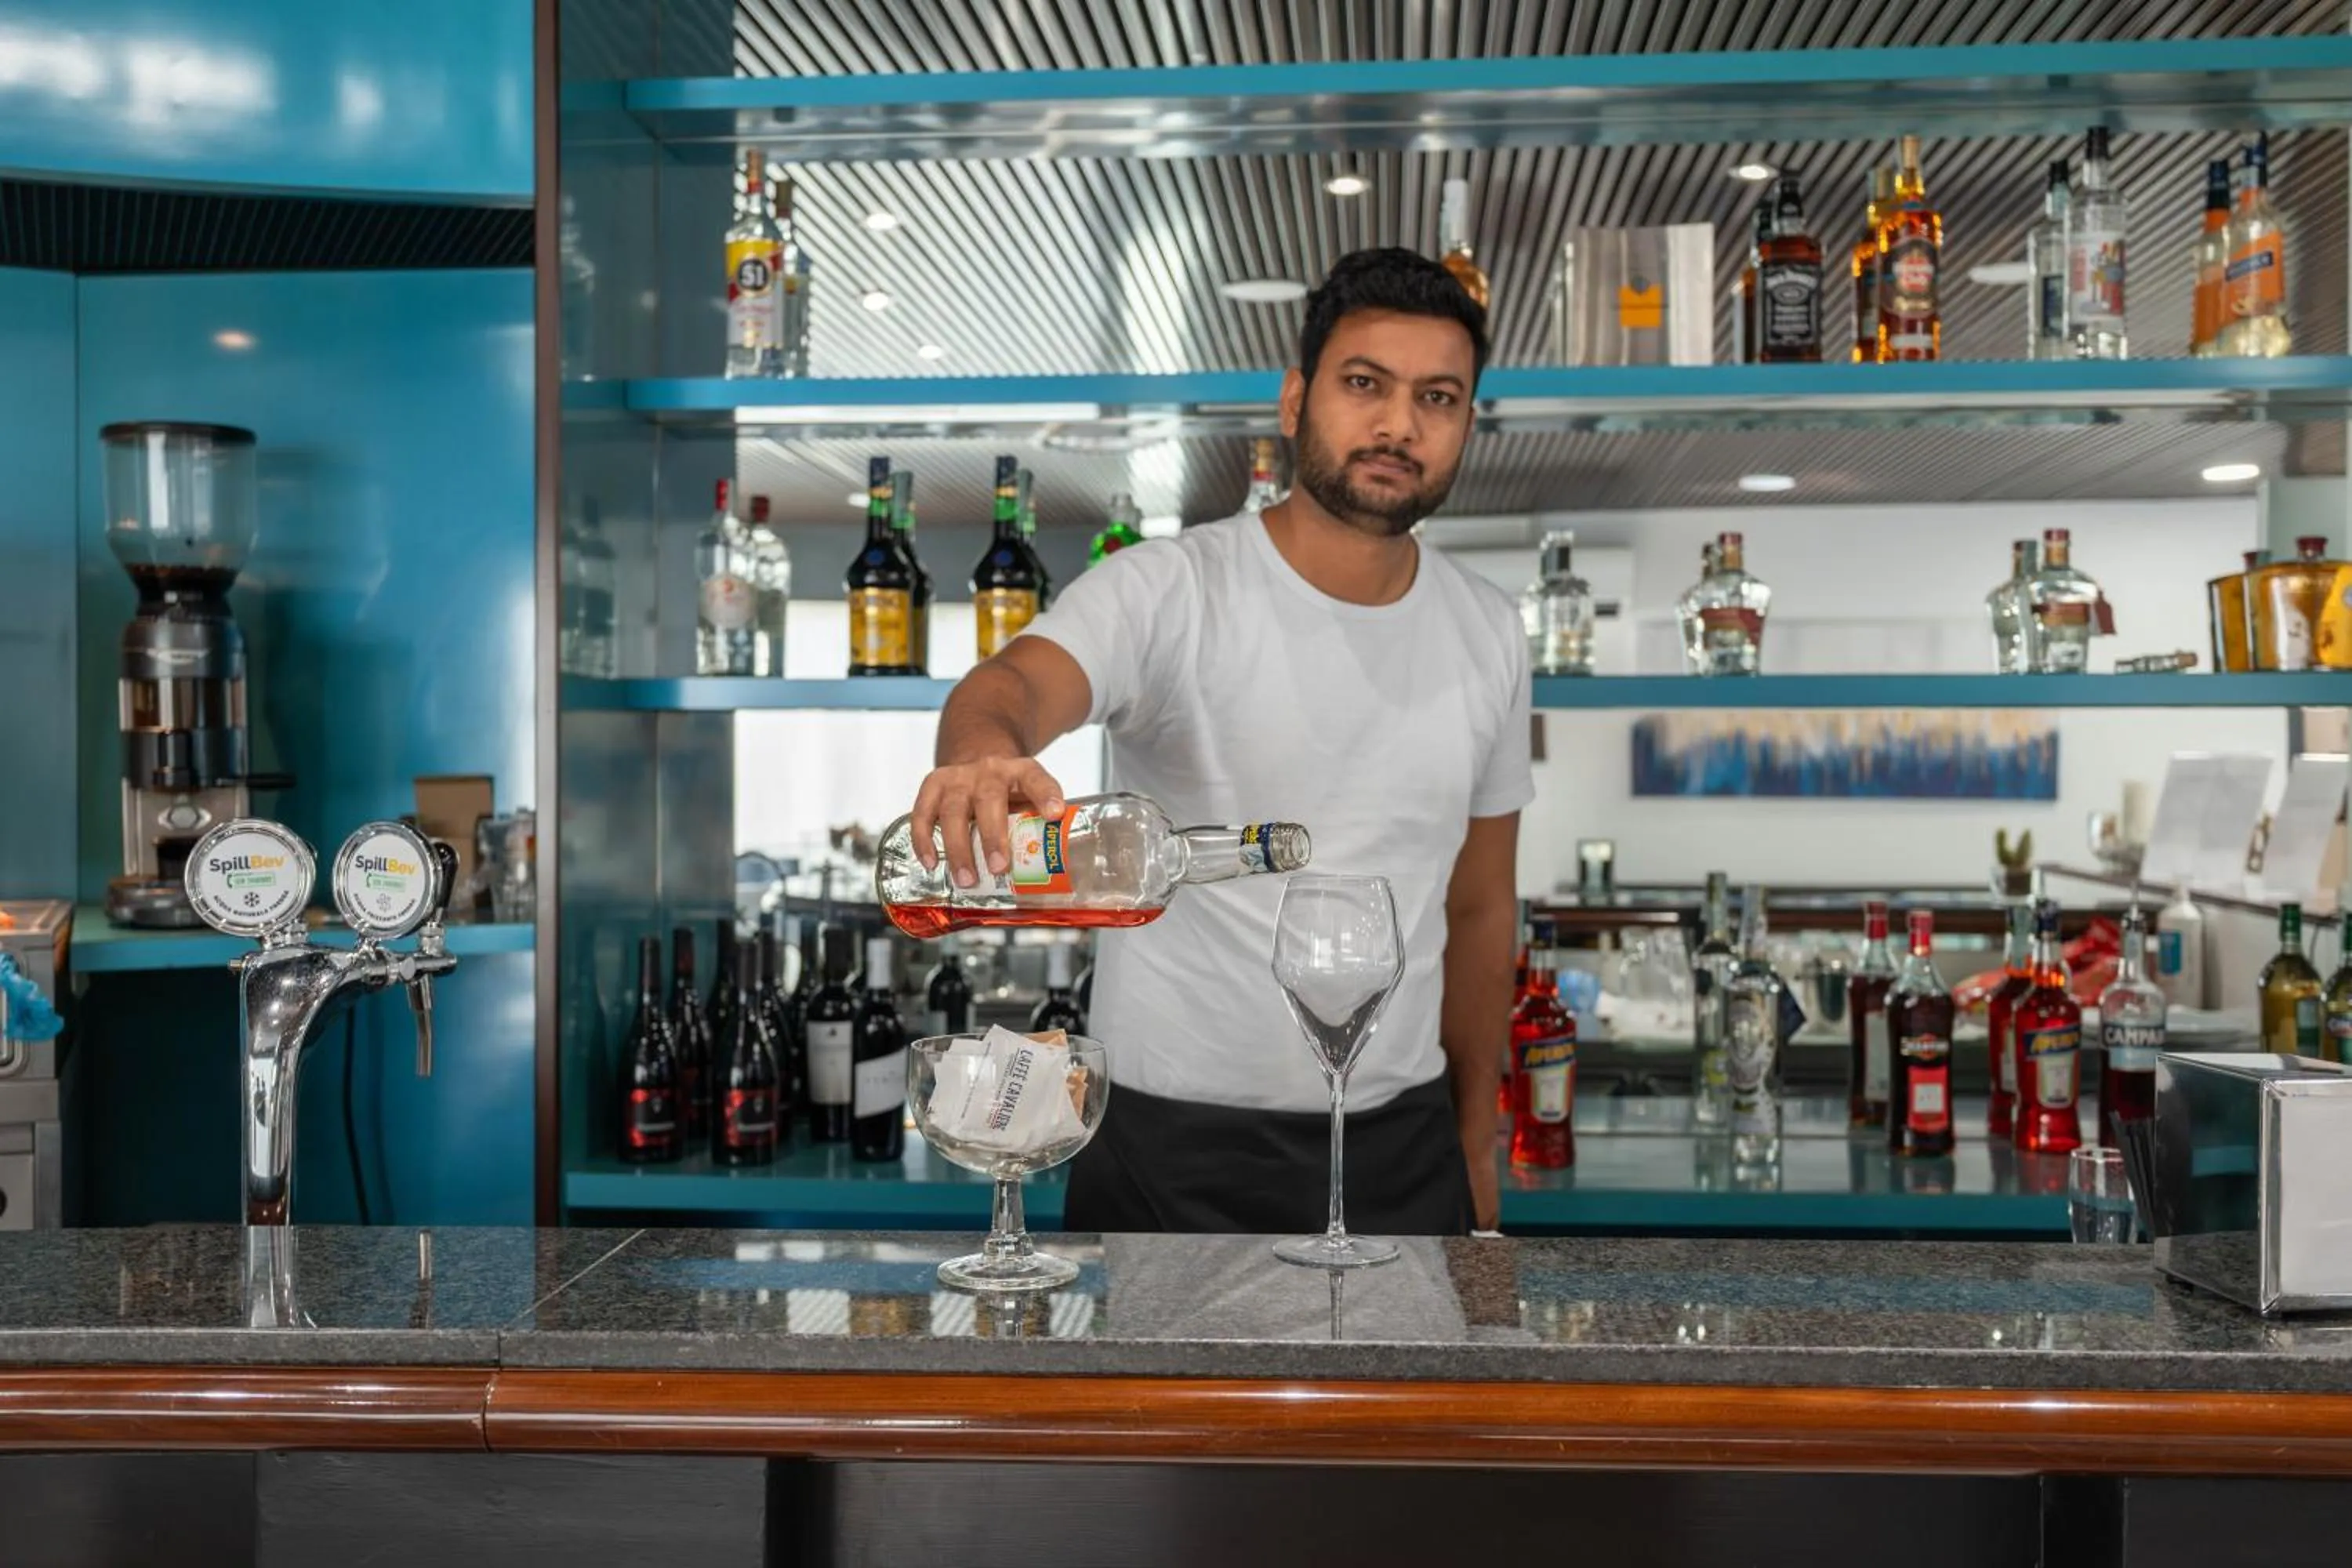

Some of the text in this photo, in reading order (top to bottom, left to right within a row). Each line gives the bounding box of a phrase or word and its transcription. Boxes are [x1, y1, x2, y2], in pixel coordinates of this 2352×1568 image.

[741, 265, 764, 290] 51
[1047, 824, 1059, 869] APEROL
[209, 855, 285, 874] SpillBev
[354, 855, 416, 875] SpillBev
